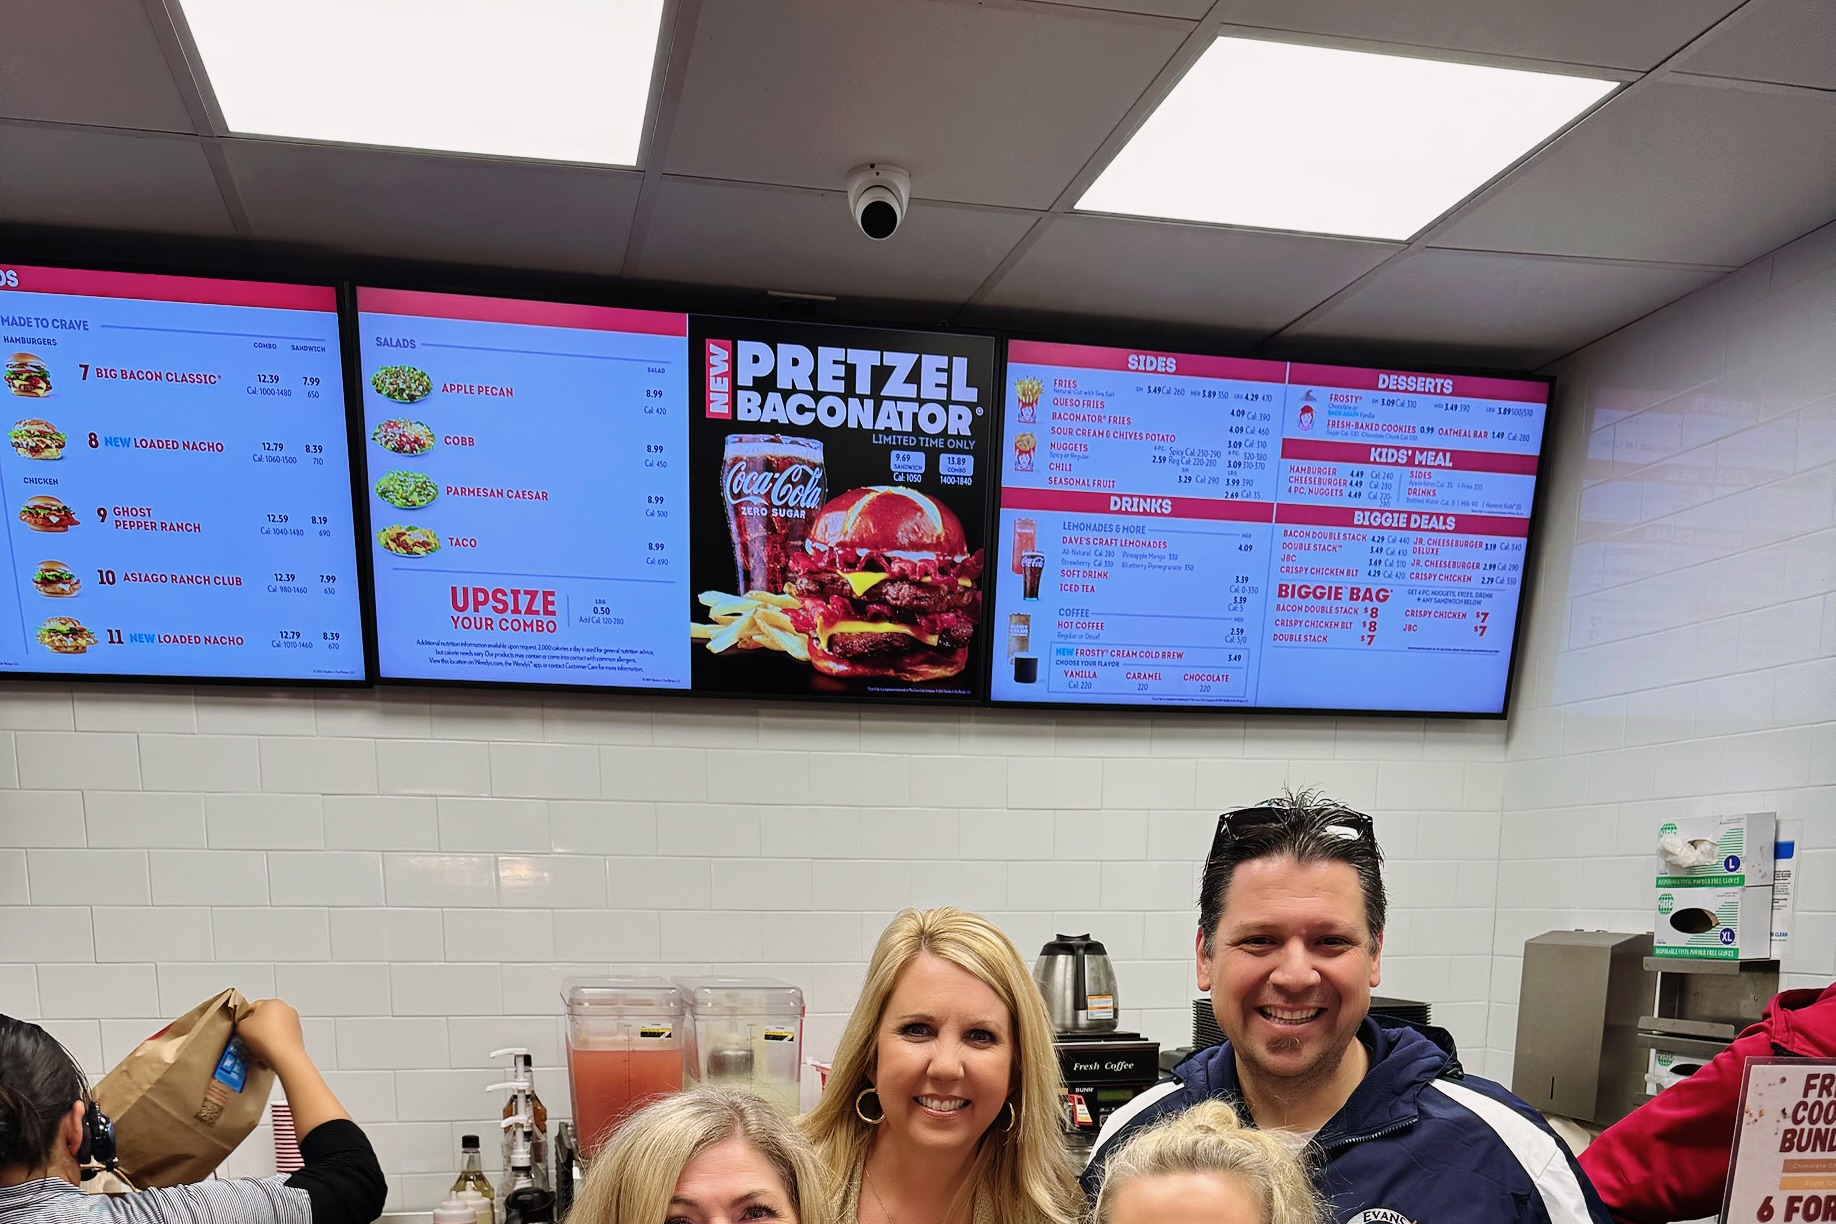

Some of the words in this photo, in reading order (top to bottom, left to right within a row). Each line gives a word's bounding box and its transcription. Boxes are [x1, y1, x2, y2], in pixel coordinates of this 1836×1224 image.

[1, 316, 34, 327] MADE
[34, 317, 49, 328] TO
[52, 319, 89, 331] CRAVE
[3, 336, 57, 346] HAMBURGERS
[254, 342, 277, 350] COMBO
[291, 344, 326, 353] SANDWICH
[375, 336, 416, 349] SALADS
[1128, 354, 1177, 373] SIDES
[78, 364, 89, 381] 7
[96, 368, 117, 379] BIG
[120, 369, 162, 381] BACON
[737, 340, 978, 402] PRETZEL
[257, 373, 279, 384] 12.39
[303, 376, 320, 386] 7.99
[708, 343, 729, 415] NEW
[1053, 379, 1077, 389] FRIES
[1378, 374, 1454, 394] DESSERTS
[442, 383, 475, 395] APPLE
[478, 385, 514, 398] PECAN
[646, 389, 663, 398] 8.99
[1052, 397, 1081, 407] QUESO
[1082, 399, 1105, 409] FRIES
[1108, 416, 1131, 425] FRIES
[1327, 420, 1380, 431] FRESH-BAKED
[1381, 424, 1416, 434] COOKIES
[444, 435, 475, 447] COBB
[1051, 426, 1073, 436] SOUR
[1076, 428, 1104, 438] CREAM
[1112, 431, 1143, 441] CHIVES
[1145, 433, 1176, 443] POTATO
[88, 432, 99, 448] 8
[105, 436, 130, 448] NEW
[134, 438, 179, 450] LOADED
[182, 440, 224, 452] NACHO
[262, 442, 284, 452] 12.79
[305, 445, 323, 454] 8.39
[873, 434, 916, 448] LIMITED
[919, 436, 945, 448] TIME
[947, 438, 976, 450] ONLY
[1050, 442, 1088, 452] NUGGETS
[646, 445, 664, 454] 8.99
[895, 453, 911, 462] 9.69
[947, 456, 966, 466] 13.89
[1370, 447, 1413, 464] KIDS'
[1414, 450, 1453, 468] MEAL
[1049, 462, 1072, 472] CHILI
[1289, 465, 1337, 476] HAMBURGER
[23, 477, 59, 486] CHICKEN
[725, 461, 822, 509] Coca-Cola
[940, 476, 972, 486] 1400-1840
[1048, 477, 1091, 488] SEASONAL
[1092, 480, 1116, 489] FRUIT
[1288, 476, 1348, 487] CHEESEBURGER
[446, 486, 504, 499] PARMESAN
[506, 488, 549, 501] CAESAR
[647, 496, 664, 505] 8.99
[1109, 496, 1172, 515] DRINKS
[97, 507, 108, 523] 9
[113, 507, 152, 518] GHOST
[741, 506, 768, 518] ZERO
[772, 508, 806, 519] SUGAR
[115, 519, 158, 531] PEPPER
[160, 522, 201, 533] RANCH
[267, 514, 289, 523] 12.59
[311, 516, 328, 525] 8.19
[1354, 511, 1407, 528] BIGGIE
[1410, 514, 1456, 530] DEALS
[448, 537, 477, 548] TACO
[648, 542, 665, 552] 8.99
[1062, 537, 1091, 546] DAVE'S
[1092, 538, 1119, 548] CRAFT
[1120, 540, 1168, 549] LEMONADES
[97, 569, 116, 586] 10
[123, 572, 168, 584] ASIAGO
[171, 574, 211, 586] RANCH
[214, 576, 243, 587] CLUB
[274, 573, 296, 582] 12.39
[320, 575, 337, 584] 7.99
[450, 585, 557, 617] UPSIZE
[593, 606, 611, 616] 0.50
[1058, 608, 1090, 618] COFFEE
[1276, 604, 1303, 613] BACON
[1304, 605, 1334, 614] DOUBLE
[1335, 606, 1359, 615] STACK
[1363, 607, 1379, 619] $8
[1405, 610, 1433, 618] CRISPY
[1433, 611, 1467, 620] CHICKEN
[1475, 611, 1489, 623] $7
[450, 615, 494, 631] YOUR
[498, 618, 557, 634] COMBO
[1057, 620, 1074, 630] HOT
[1075, 622, 1105, 631] COFFEE
[107, 629, 124, 645] 11
[129, 633, 156, 644] NEW
[158, 633, 201, 645] LOADED
[203, 635, 244, 646] NACHO
[279, 631, 301, 640] 12.79
[323, 632, 340, 641] 8.39
[1064, 670, 1097, 679] VANILLA
[1126, 672, 1162, 681] CARAMEL
[1183, 673, 1230, 683] CHOCOLATE
[1729, 858, 1735, 869] L
[1721, 931, 1733, 942] XL
[1073, 1062, 1100, 1071] Fresh
[1104, 1061, 1134, 1072] Coffee
[1803, 1073, 1836, 1099] FR
[1756, 1195, 1774, 1223] 6
[1784, 1195, 1836, 1223] FOR
